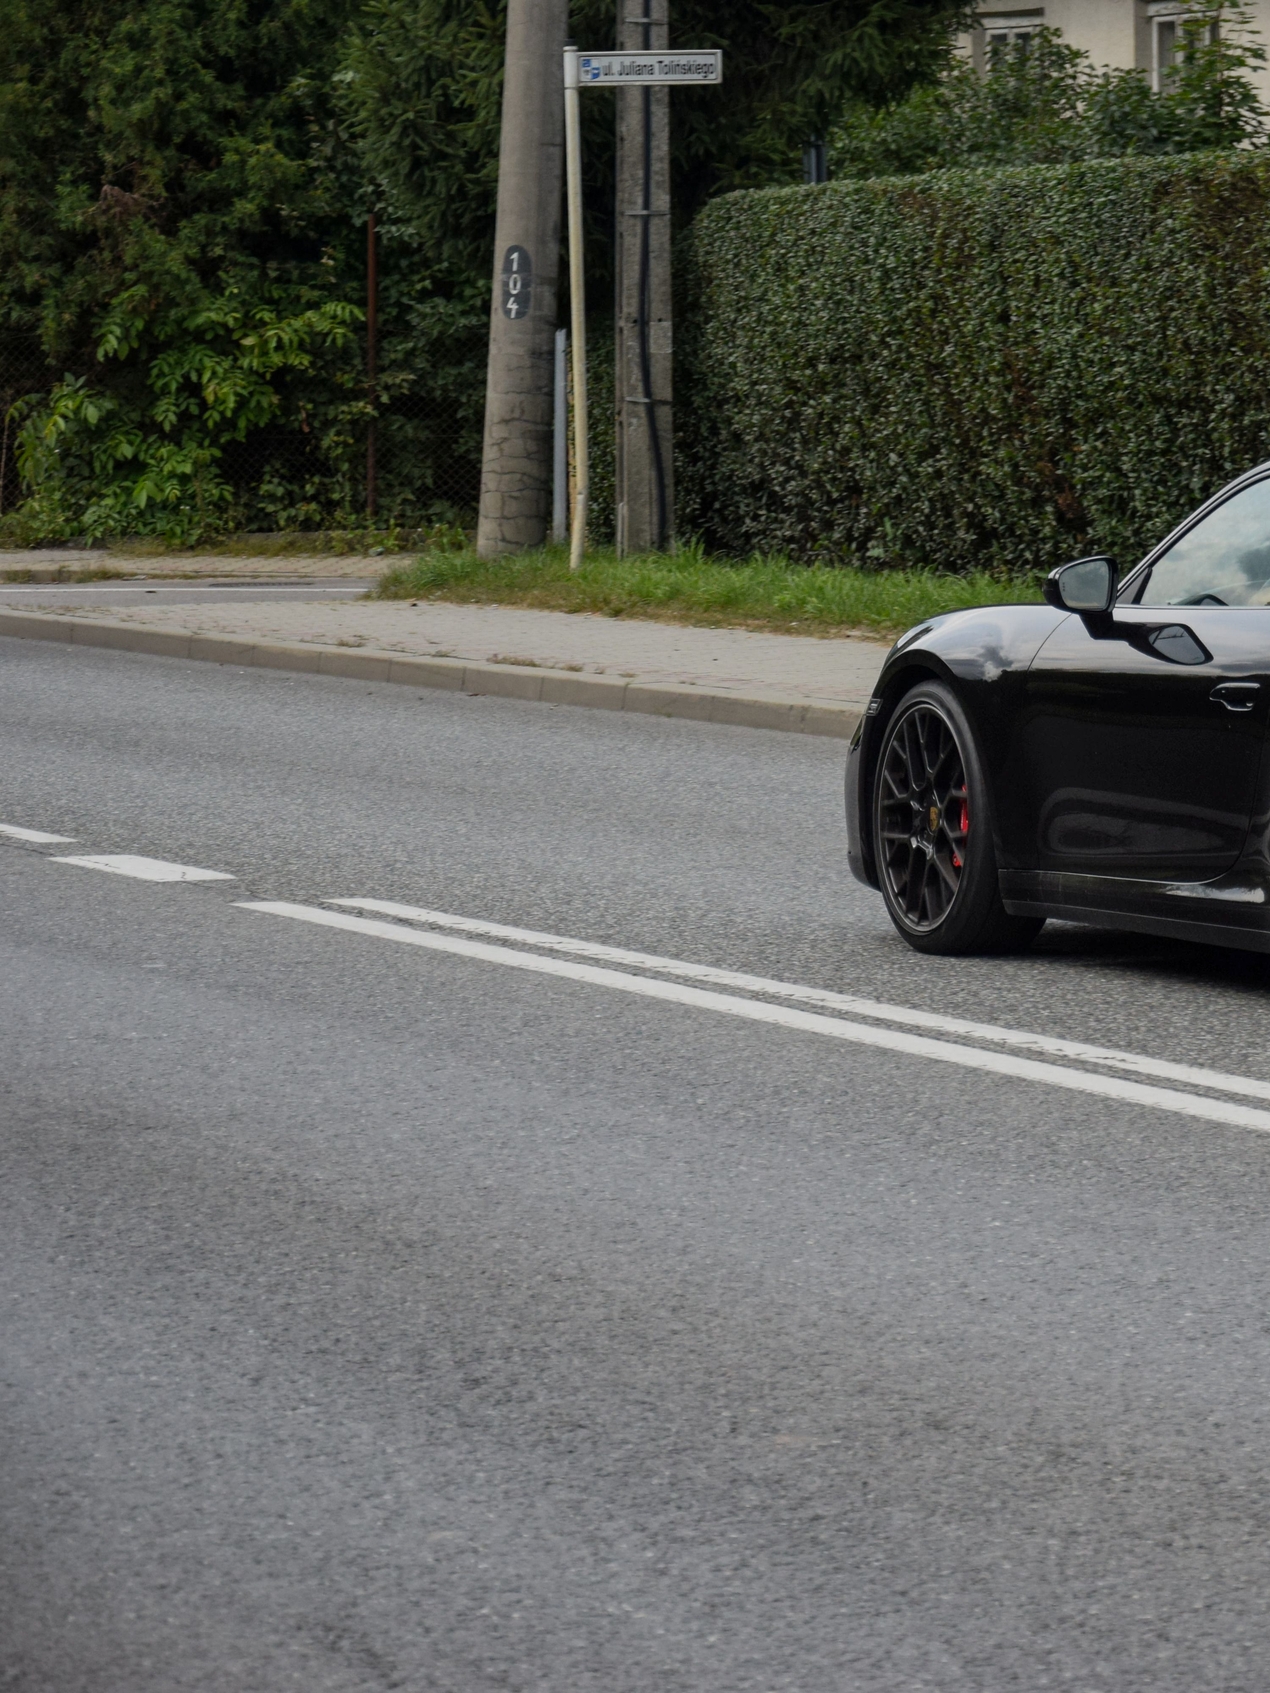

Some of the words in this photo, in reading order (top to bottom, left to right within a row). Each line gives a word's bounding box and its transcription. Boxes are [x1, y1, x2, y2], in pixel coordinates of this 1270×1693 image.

[602, 61, 615, 76] ul.
[617, 60, 655, 76] Juliana
[656, 59, 715, 78] Tolińskiego
[506, 252, 521, 318] 104
